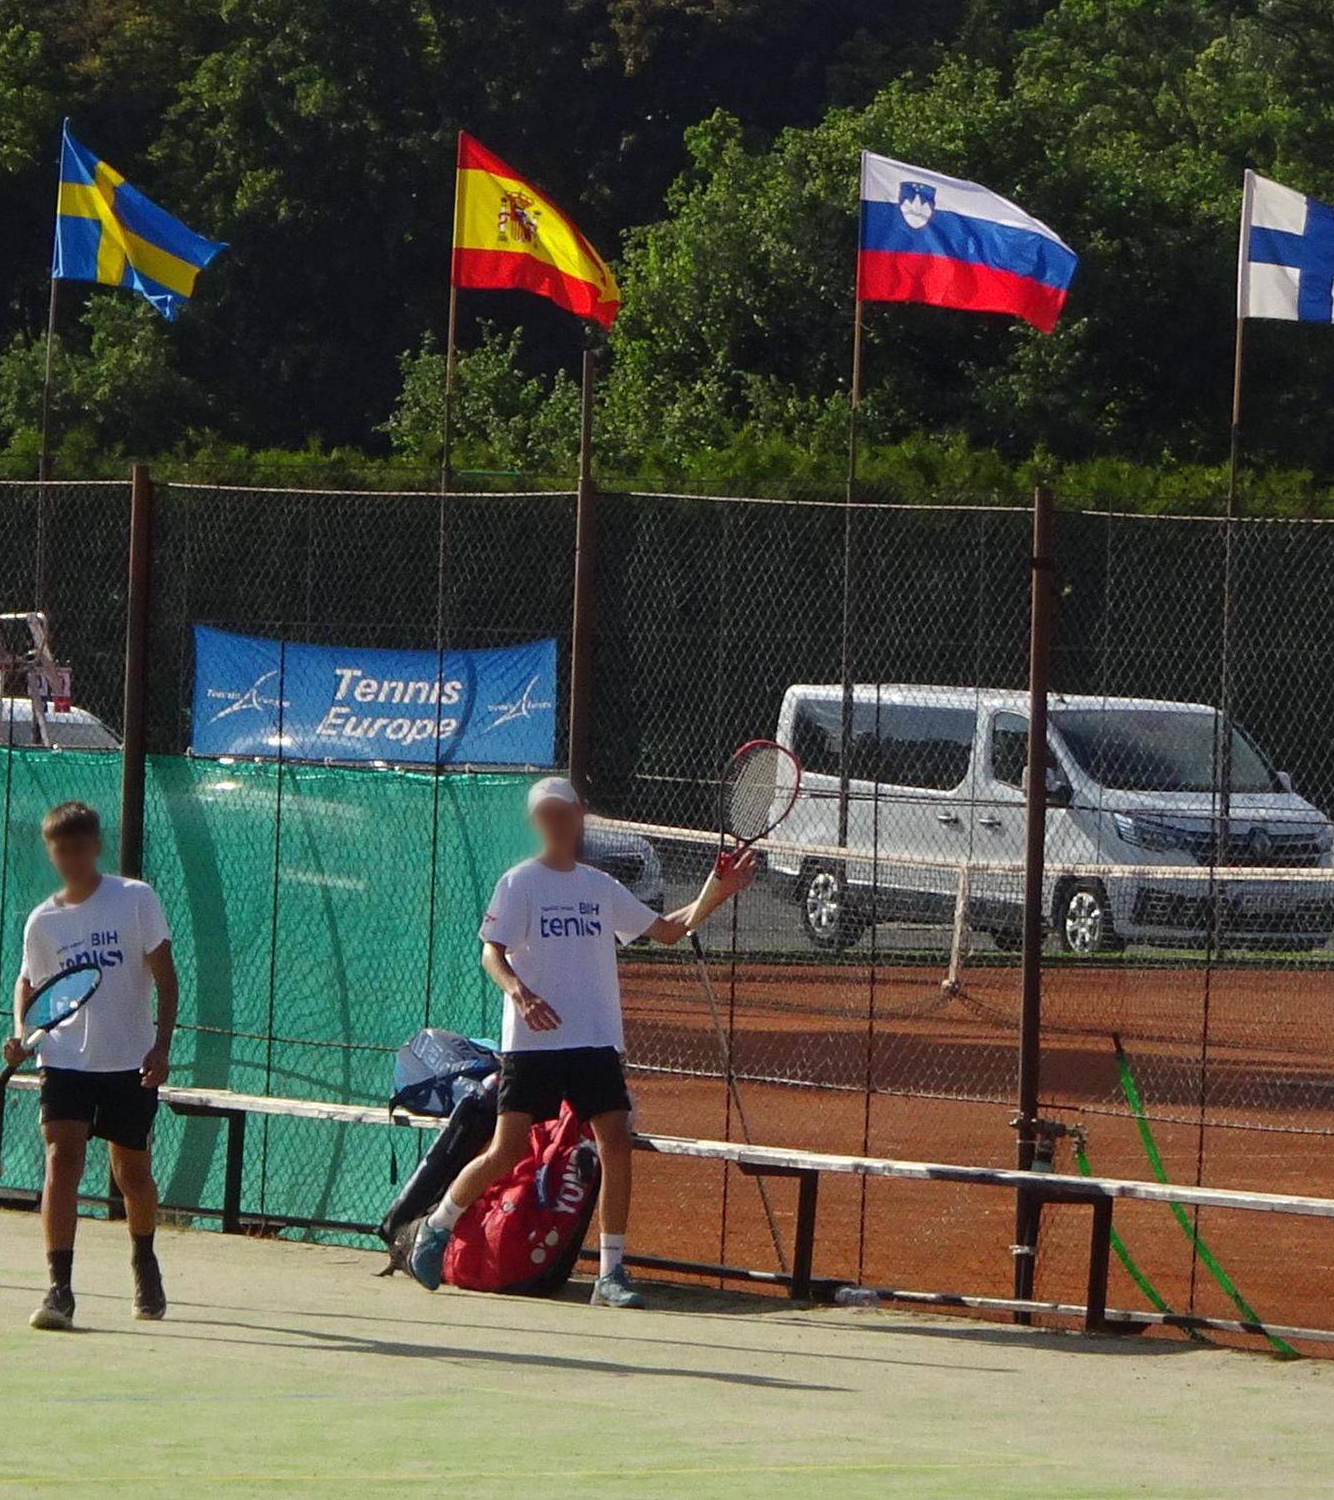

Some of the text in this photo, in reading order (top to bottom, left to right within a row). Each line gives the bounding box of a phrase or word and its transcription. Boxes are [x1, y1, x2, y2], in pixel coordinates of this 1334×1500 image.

[334, 668, 463, 705] Tennis
[316, 706, 458, 746] Europe
[578, 901, 600, 916] BIH
[91, 930, 118, 946] BIH
